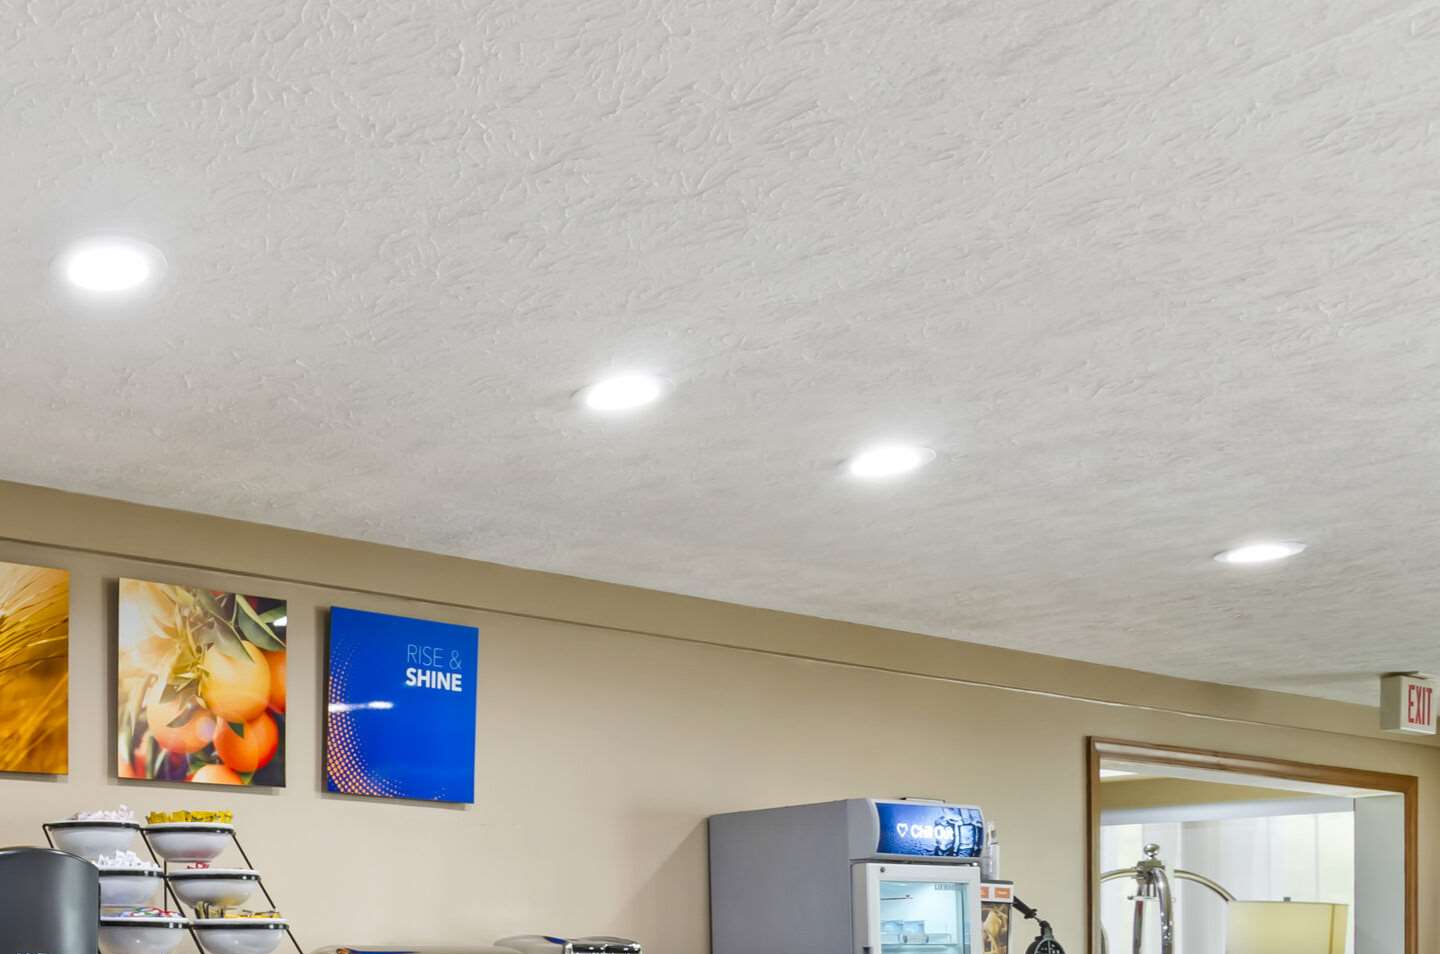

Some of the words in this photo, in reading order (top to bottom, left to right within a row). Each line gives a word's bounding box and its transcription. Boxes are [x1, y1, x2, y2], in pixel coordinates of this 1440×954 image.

[407, 644, 443, 668] RISE
[449, 650, 462, 669] &
[406, 668, 462, 691] SHINE
[1407, 684, 1433, 726] EXIT
